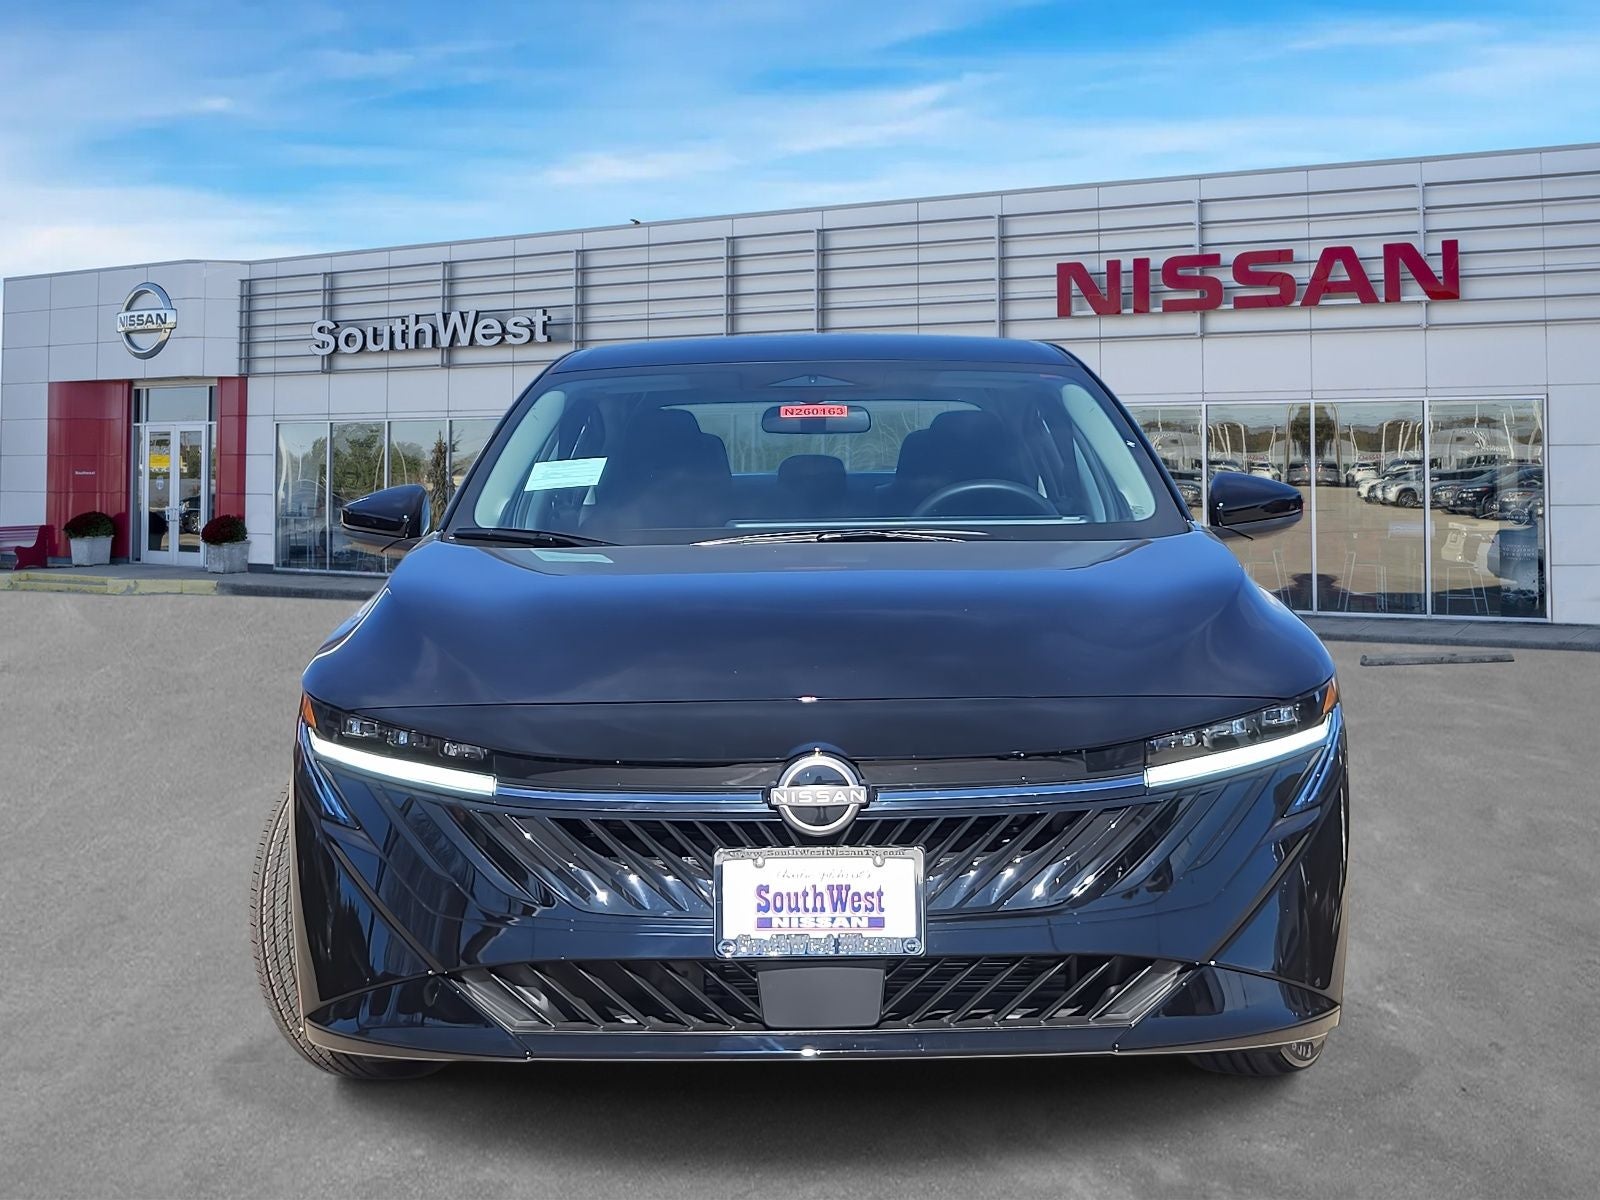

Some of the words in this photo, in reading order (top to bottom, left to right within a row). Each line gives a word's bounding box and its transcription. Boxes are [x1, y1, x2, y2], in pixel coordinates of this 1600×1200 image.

[1056, 239, 1460, 317] NISSAN
[119, 313, 167, 327] NISSAN
[310, 308, 551, 356] SouthWest
[785, 408, 844, 416] N260163
[773, 788, 866, 804] NISSAN
[756, 884, 885, 913] SouthWest
[771, 916, 869, 928] NISSAN
